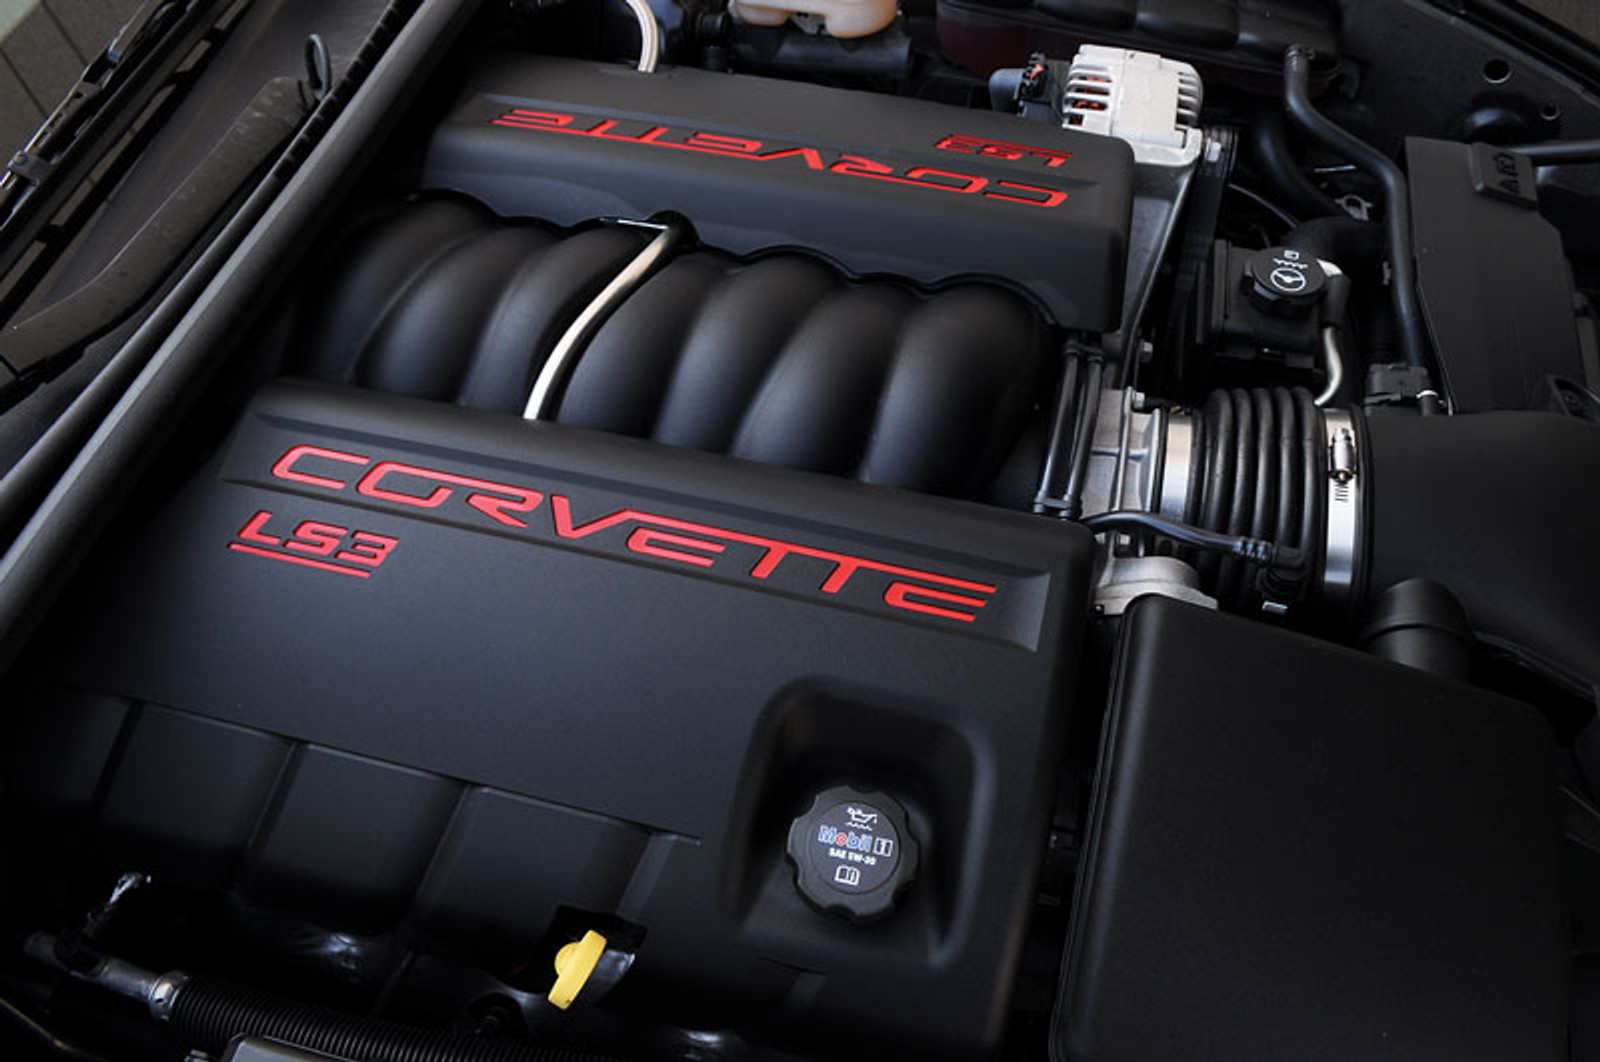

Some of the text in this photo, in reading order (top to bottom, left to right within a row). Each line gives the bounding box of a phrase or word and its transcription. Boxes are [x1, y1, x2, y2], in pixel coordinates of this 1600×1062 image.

[492, 109, 1069, 208] CORVETTE
[937, 134, 1072, 169] LS3
[237, 511, 397, 568] LS3
[272, 444, 997, 623] CORVETTE
[818, 824, 873, 852] Mobil
